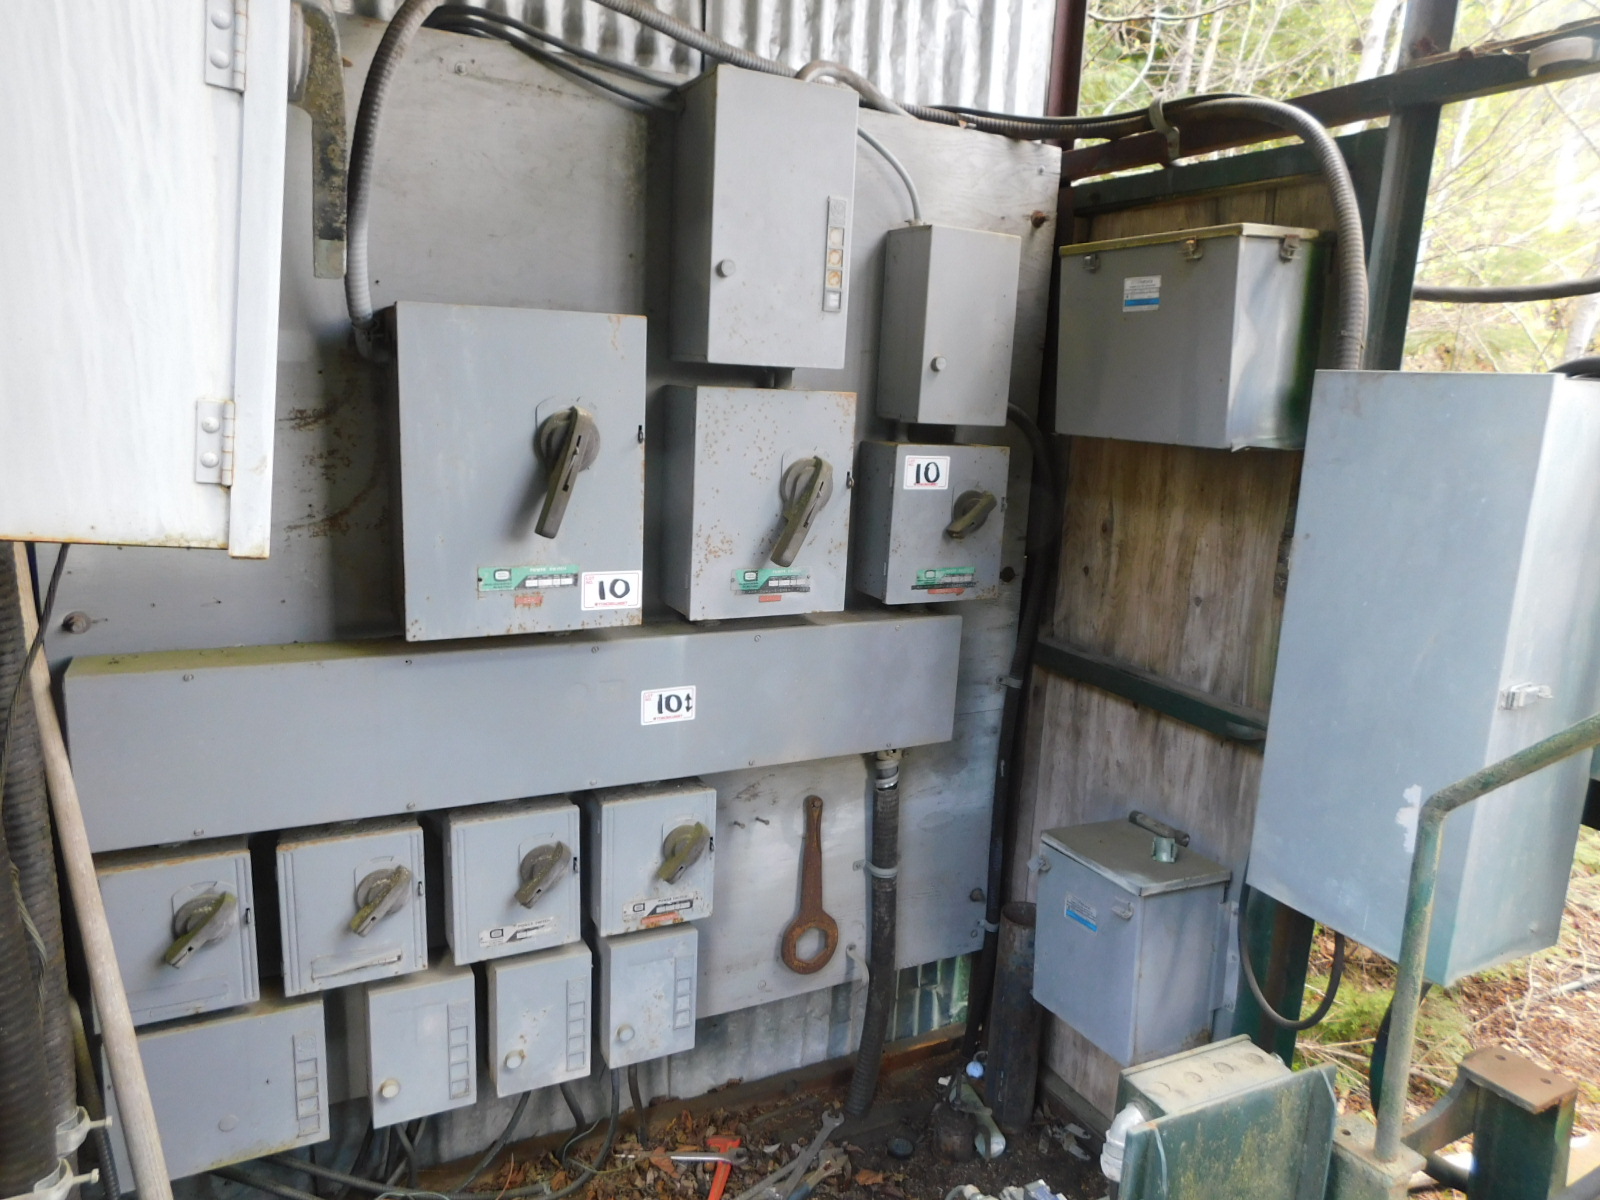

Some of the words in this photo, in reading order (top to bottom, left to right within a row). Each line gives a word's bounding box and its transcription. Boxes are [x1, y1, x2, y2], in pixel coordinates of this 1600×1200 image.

[915, 461, 940, 484] 10
[598, 578, 631, 600] 10
[657, 693, 683, 715] 10
